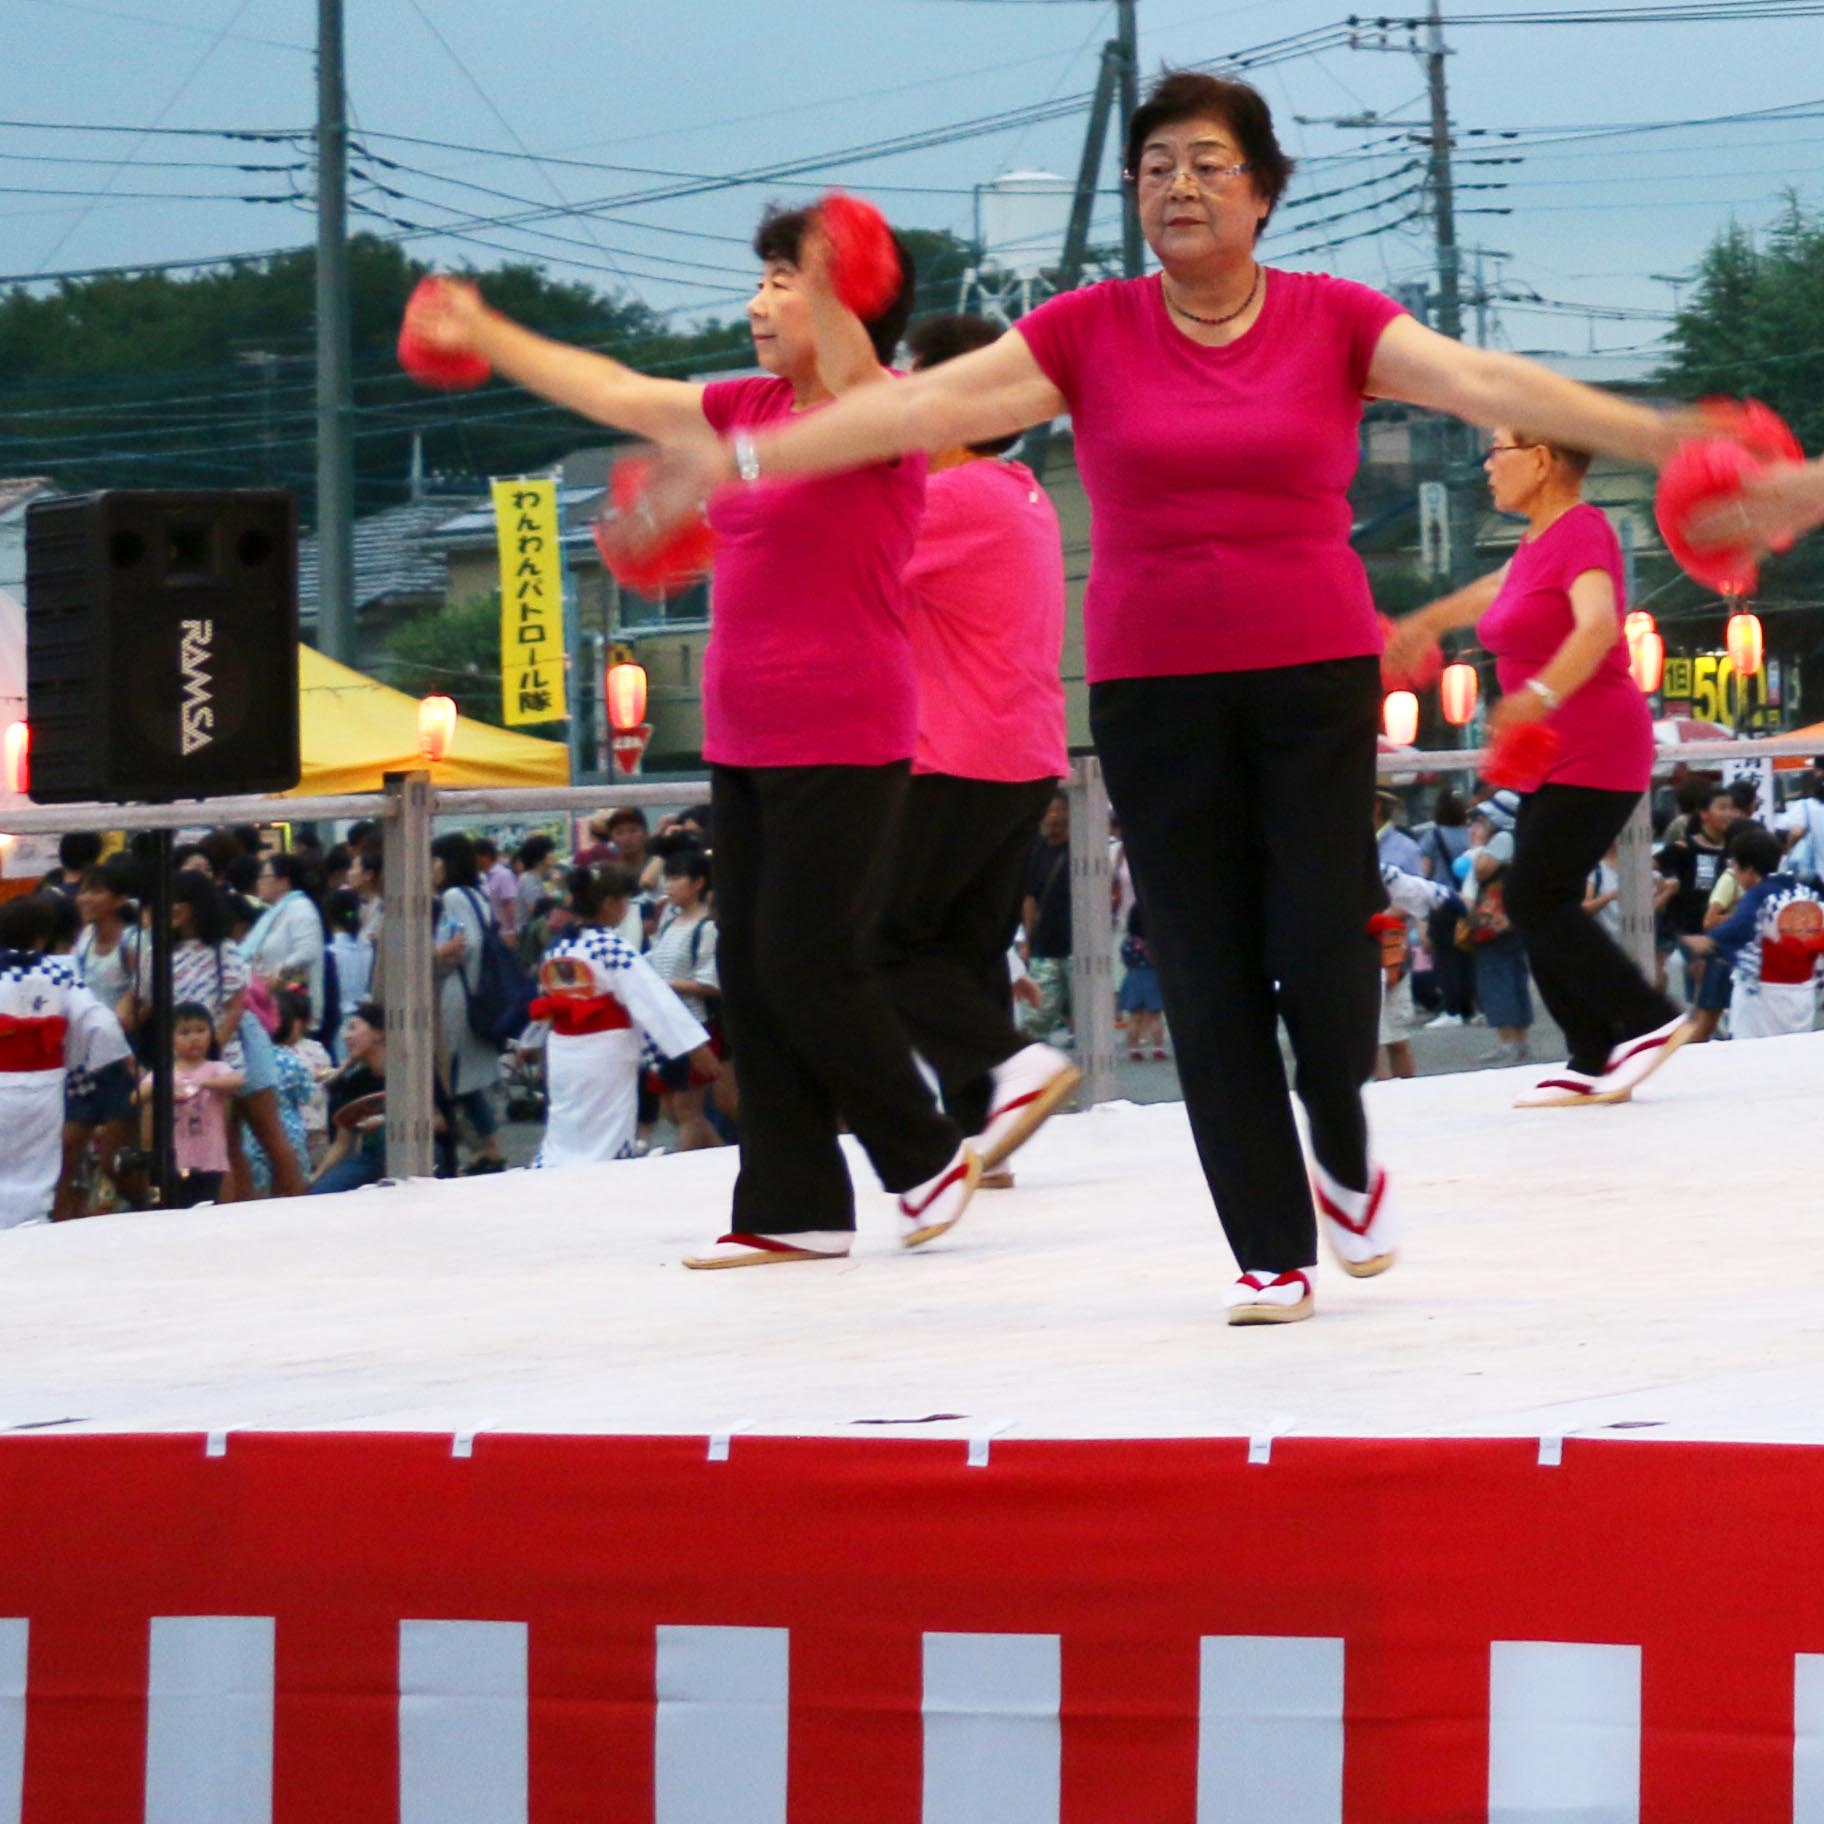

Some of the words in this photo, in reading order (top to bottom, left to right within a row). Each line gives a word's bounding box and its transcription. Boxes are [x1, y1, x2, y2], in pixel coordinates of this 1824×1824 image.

[180, 620, 214, 756] RAMSA
[511, 490, 553, 714] わんわんパトロール隊
